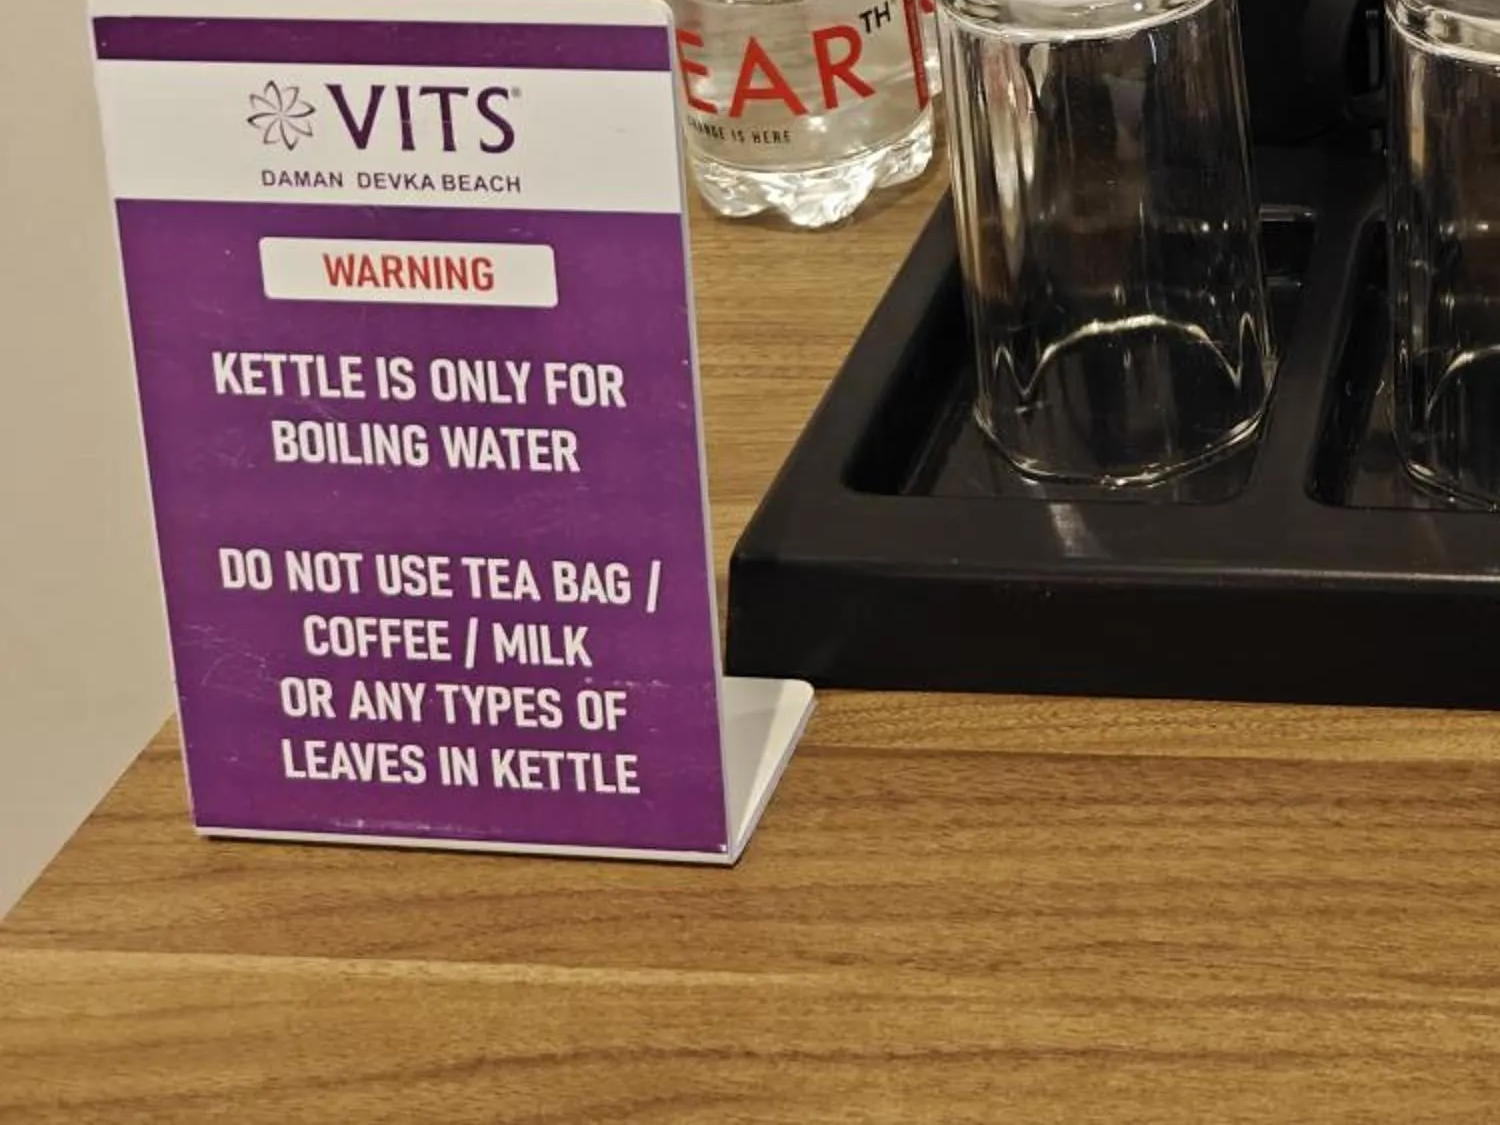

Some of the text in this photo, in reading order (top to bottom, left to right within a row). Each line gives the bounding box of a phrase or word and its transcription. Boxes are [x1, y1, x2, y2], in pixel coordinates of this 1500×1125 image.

[732, 129, 747, 144] IS
[752, 129, 793, 145] HERE
[261, 169, 523, 195] DAMAN DEVKA BEACH
[321, 252, 496, 293] WARNING
[211, 351, 627, 408] KETTLE IS ONLY FOR
[270, 419, 581, 474] BOILING WATER
[218, 547, 662, 613] DO NOT USE TEA BAG /
[303, 615, 593, 669] COFFEE / MILK
[280, 676, 628, 732] OR ANY TYPES OF
[281, 738, 641, 795] LEAVES IN KETTLE
